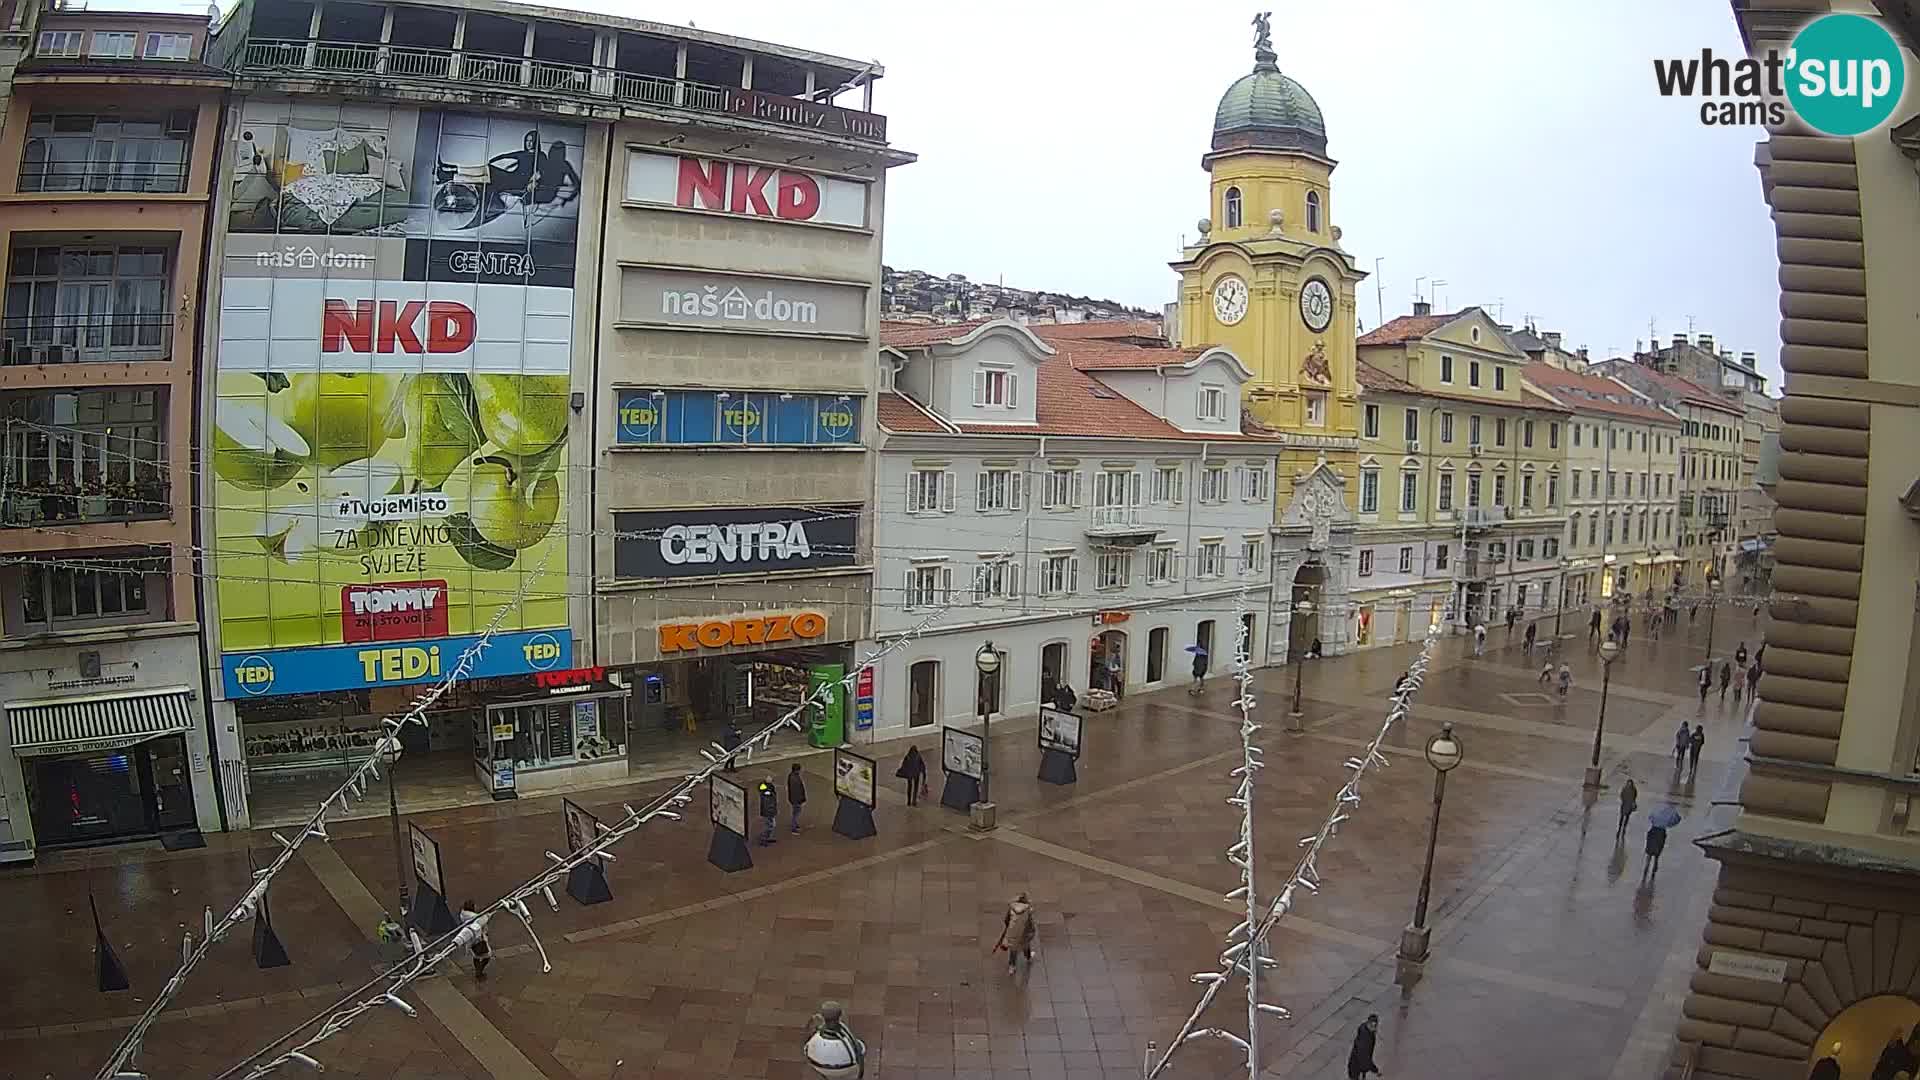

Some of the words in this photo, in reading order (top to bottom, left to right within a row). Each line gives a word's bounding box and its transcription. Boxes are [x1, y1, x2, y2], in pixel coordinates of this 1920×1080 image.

[724, 90, 746, 112] Le
[676, 158, 821, 221] NKD
[256, 246, 295, 269] naš
[320, 247, 366, 270] dom
[449, 250, 535, 276] CENTRA
[662, 285, 718, 317] naš
[754, 291, 817, 323] dom
[322, 299, 477, 353] NKD
[620, 409, 658, 425] TEDi
[724, 410, 760, 426] TEDi
[820, 412, 853, 427] TEDi
[339, 497, 447, 516] #TvojeMisto
[335, 529, 358, 549] ZA
[367, 525, 450, 547] DNEVNO
[660, 520, 811, 564] CENTRA
[360, 546, 427, 575] SVJEŽE
[350, 587, 439, 615] TOMMY
[659, 612, 826, 654] KORZO
[359, 646, 440, 682] TEDi
[523, 643, 561, 661] TEDi
[235, 666, 274, 684] TEDi
